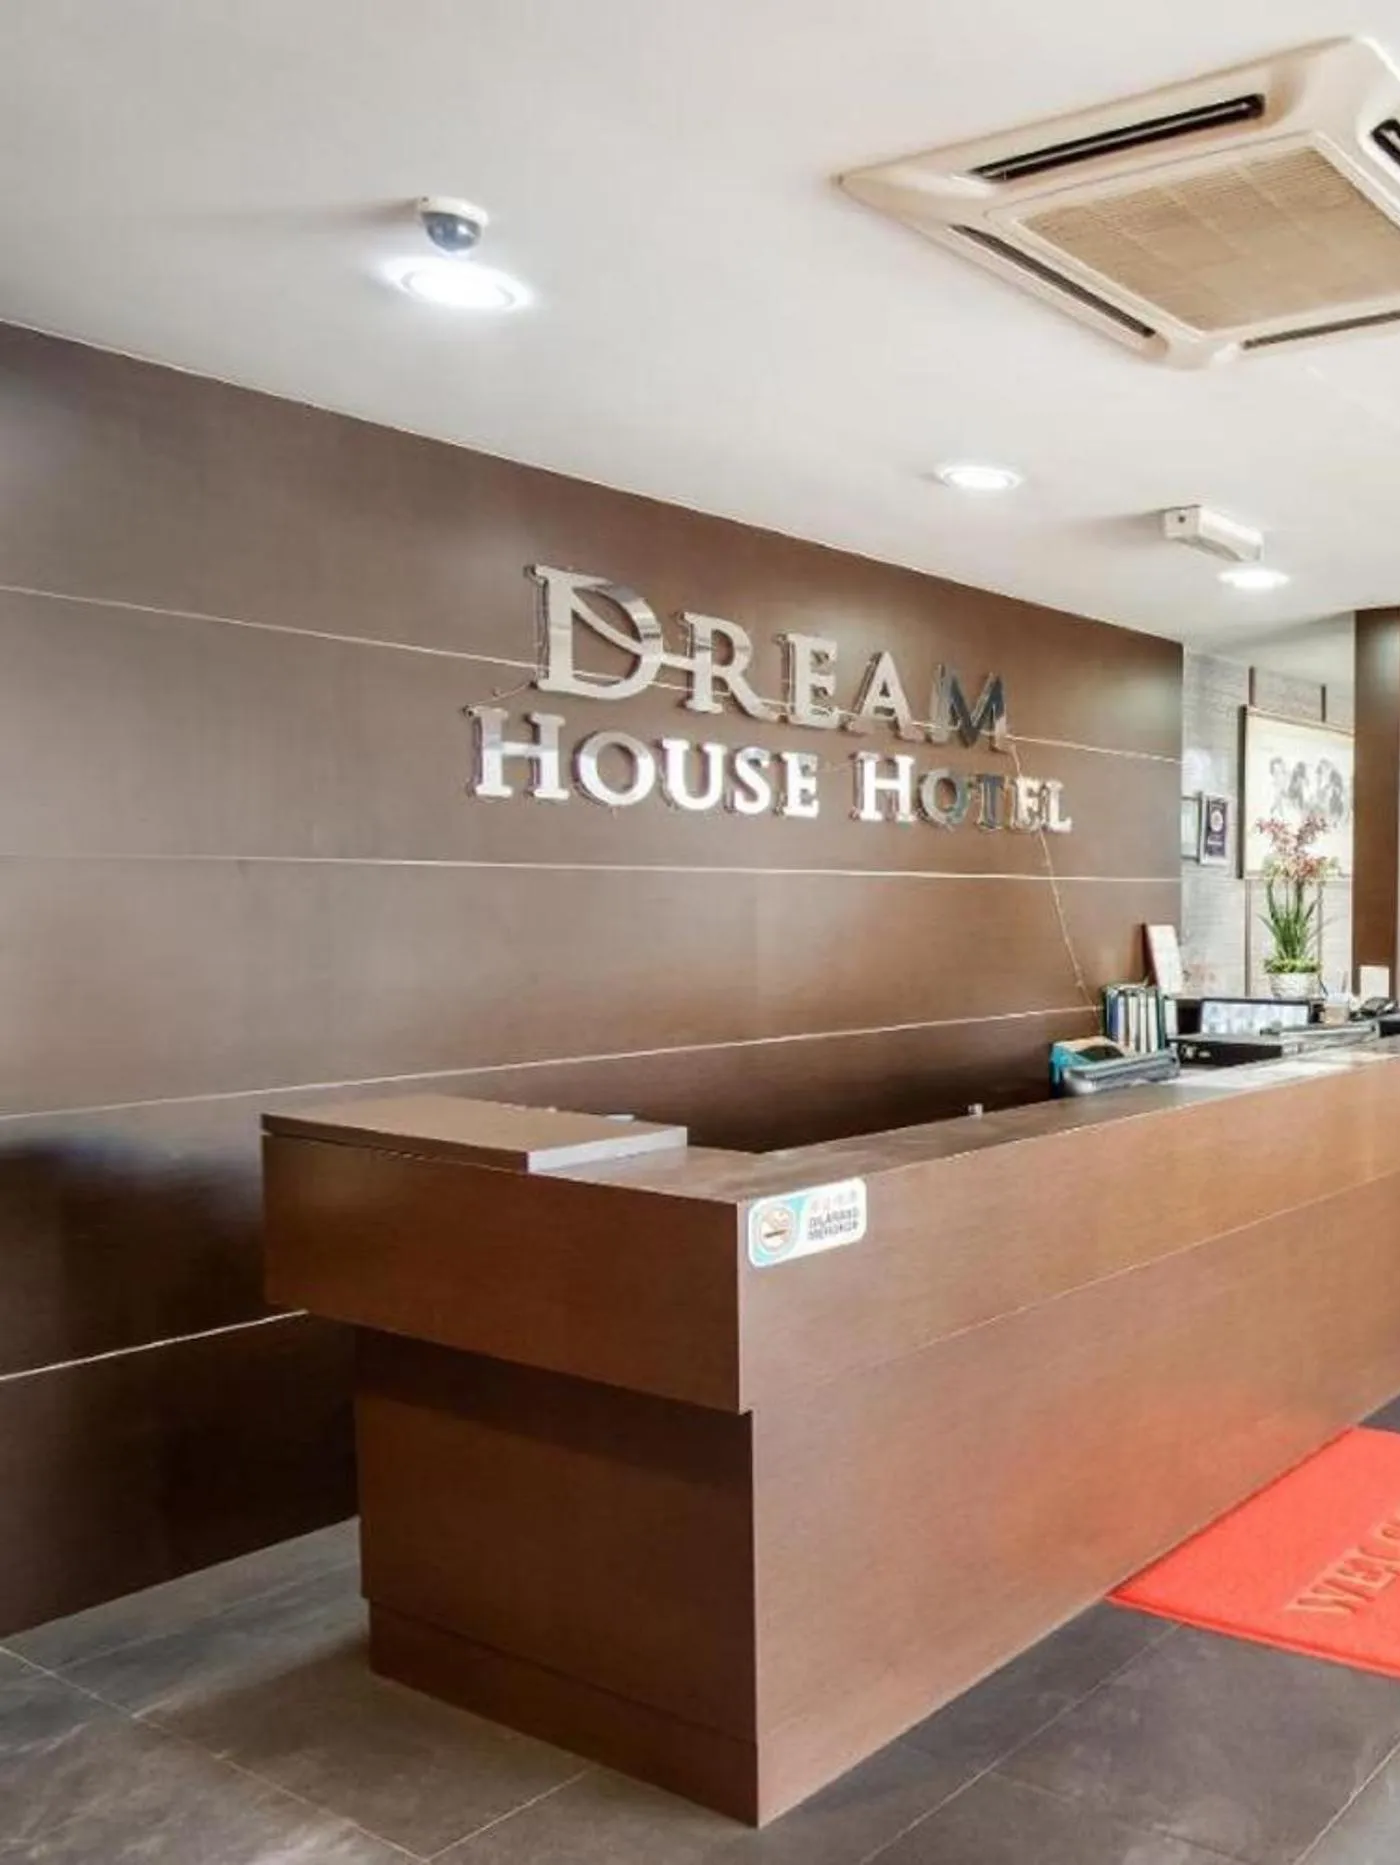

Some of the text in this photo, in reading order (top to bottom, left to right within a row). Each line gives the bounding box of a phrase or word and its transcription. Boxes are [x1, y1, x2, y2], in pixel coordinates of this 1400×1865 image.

[527, 565, 1016, 752] DREAM
[468, 705, 1072, 833] HOUSE HOTEL
